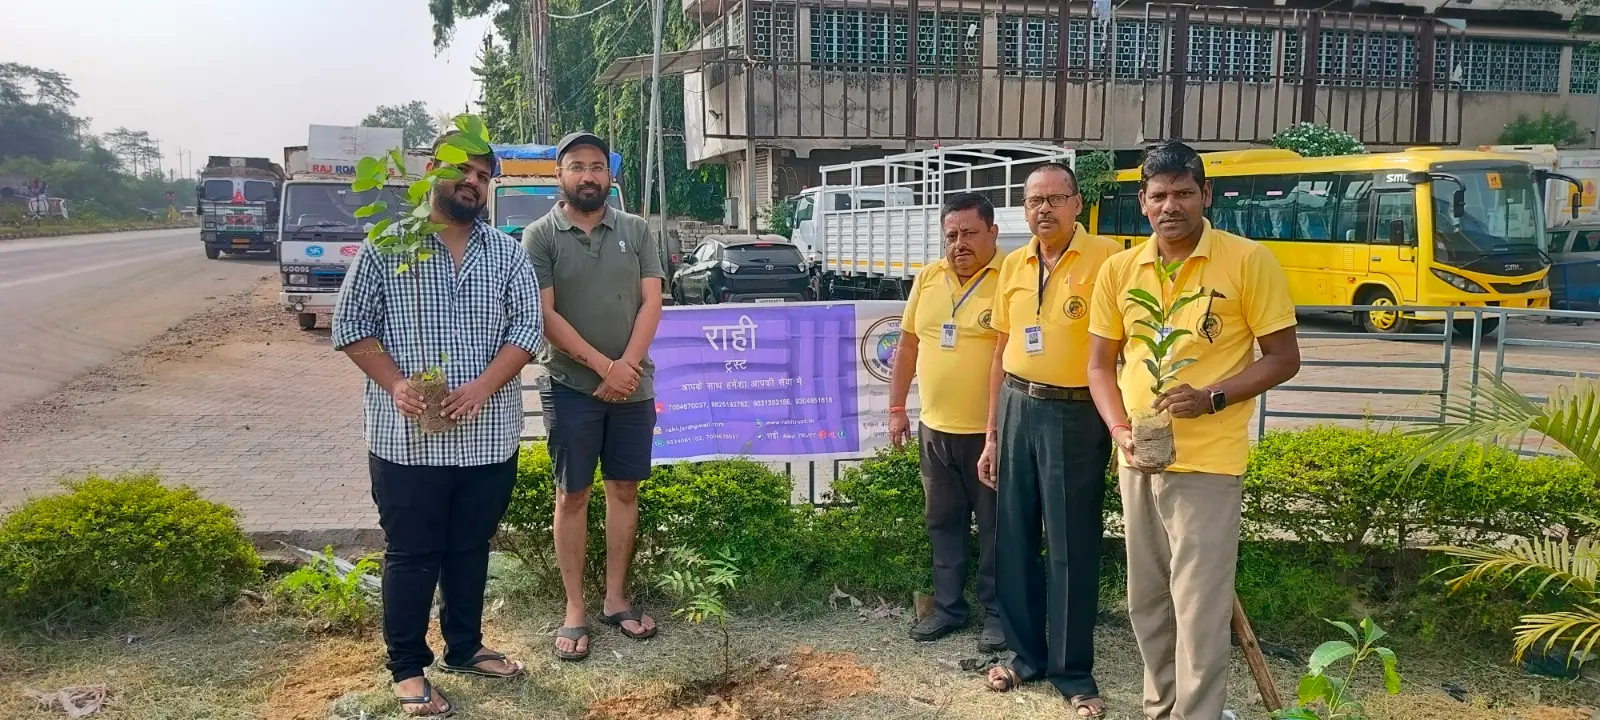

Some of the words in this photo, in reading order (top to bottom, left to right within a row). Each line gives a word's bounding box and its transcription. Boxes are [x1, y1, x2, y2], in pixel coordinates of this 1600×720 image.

[312, 164, 333, 173] RAJ
[335, 165, 356, 174] ROA
[1385, 173, 1409, 183] SML
[282, 265, 310, 273] GOODS
[1504, 263, 1523, 271] SML
[702, 314, 758, 351] राही
[723, 359, 747, 373] ट्रस्ट
[681, 380, 703, 392] आपके
[706, 381, 723, 391] साथ
[751, 376, 775, 388] आपकी
[778, 376, 793, 387] सेवा
[766, 430, 779, 440] राही
